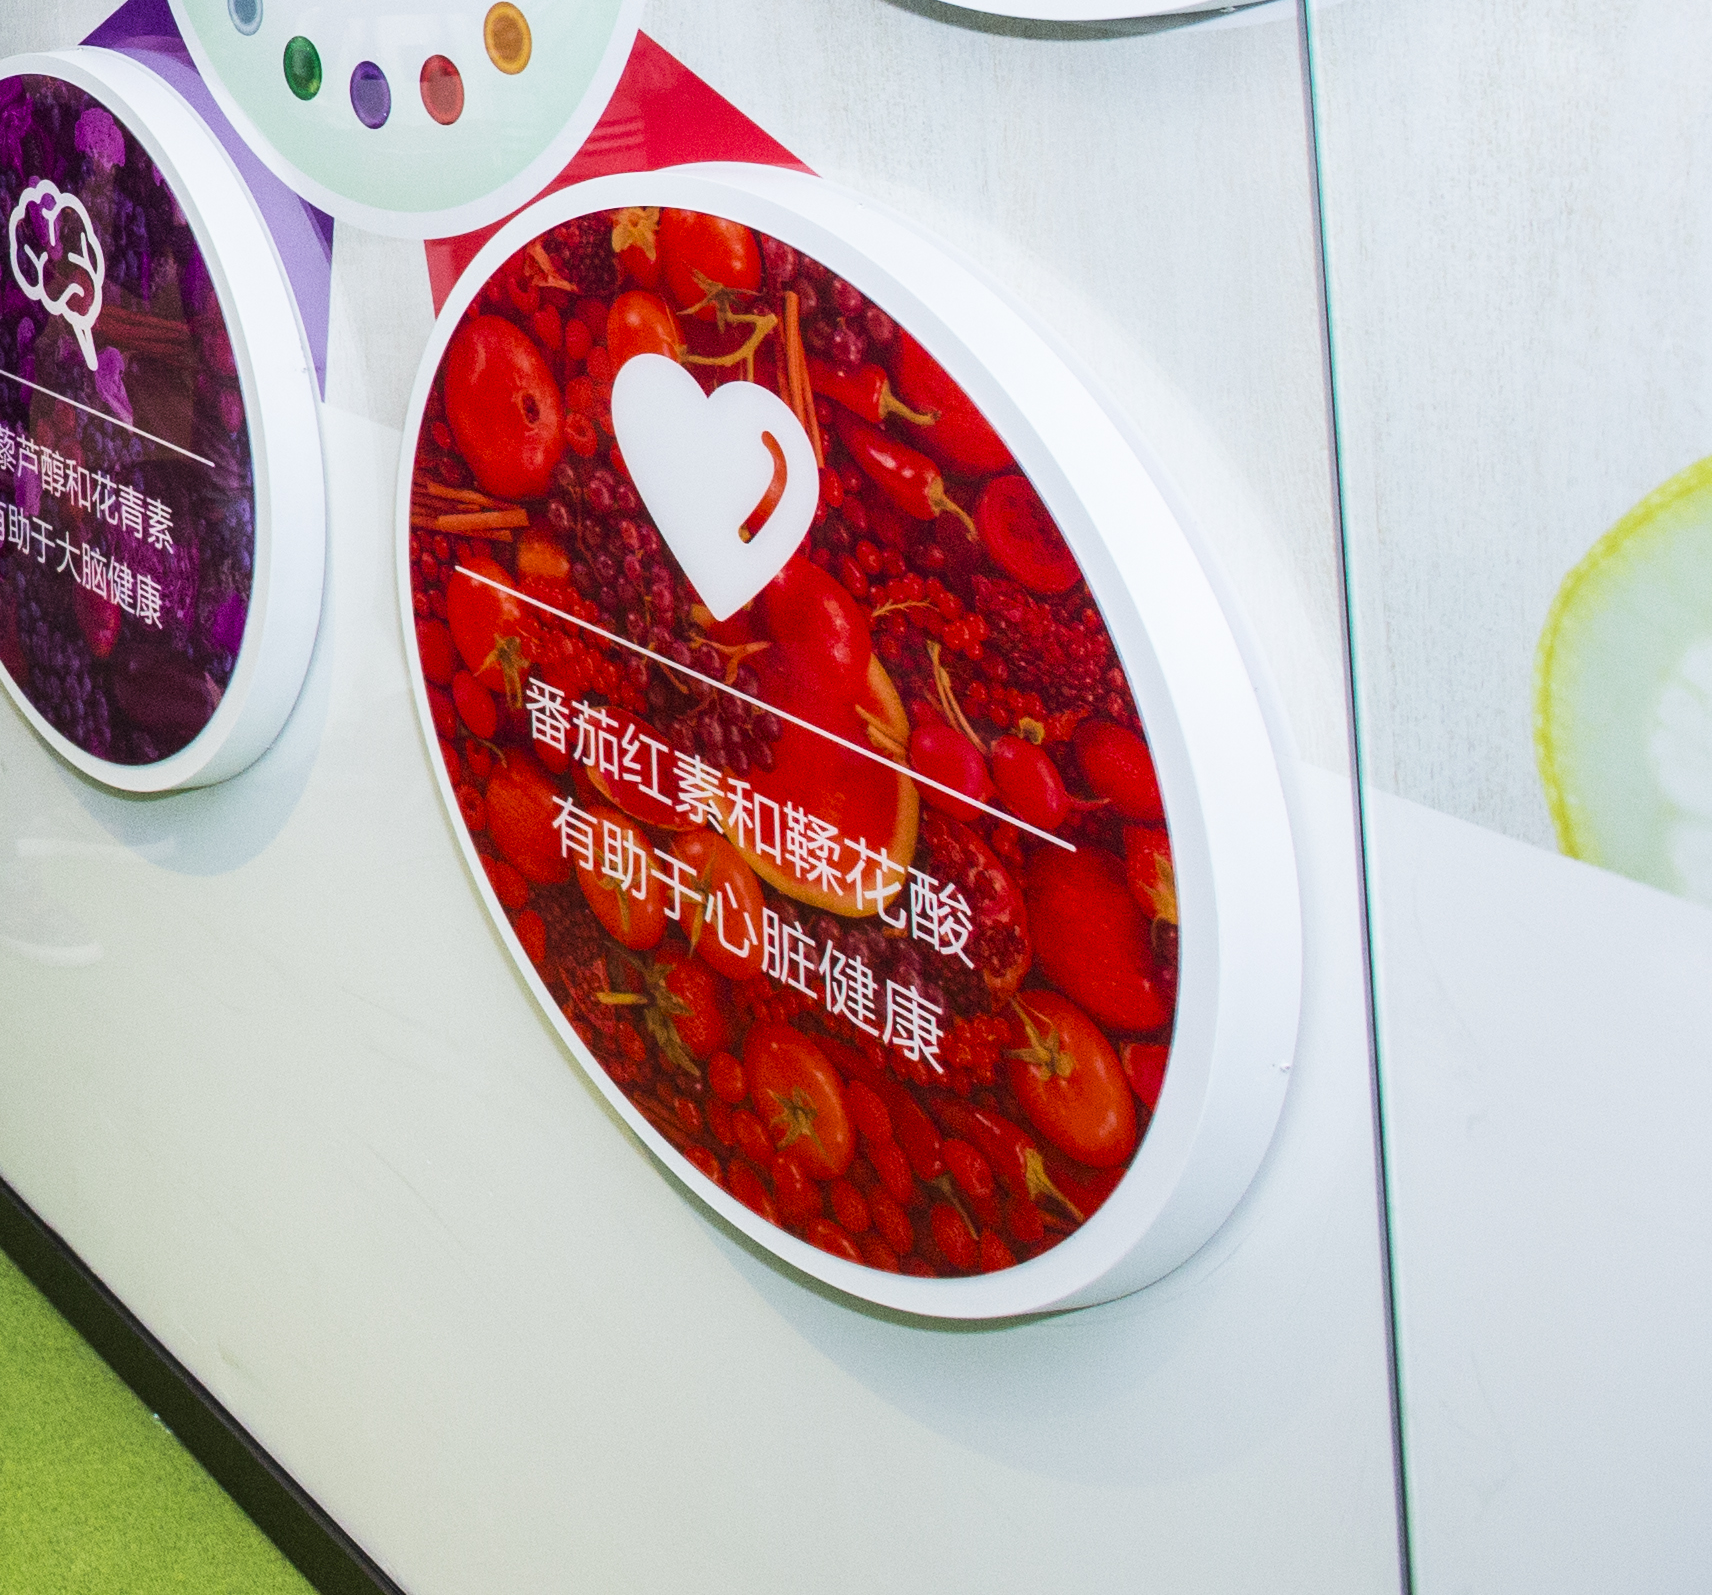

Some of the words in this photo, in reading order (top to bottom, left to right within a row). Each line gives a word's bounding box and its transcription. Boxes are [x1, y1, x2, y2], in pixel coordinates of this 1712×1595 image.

[525, 677, 975, 970] 番茄红素和鞣花酸
[552, 795, 946, 1074] 有助于心脏健康
